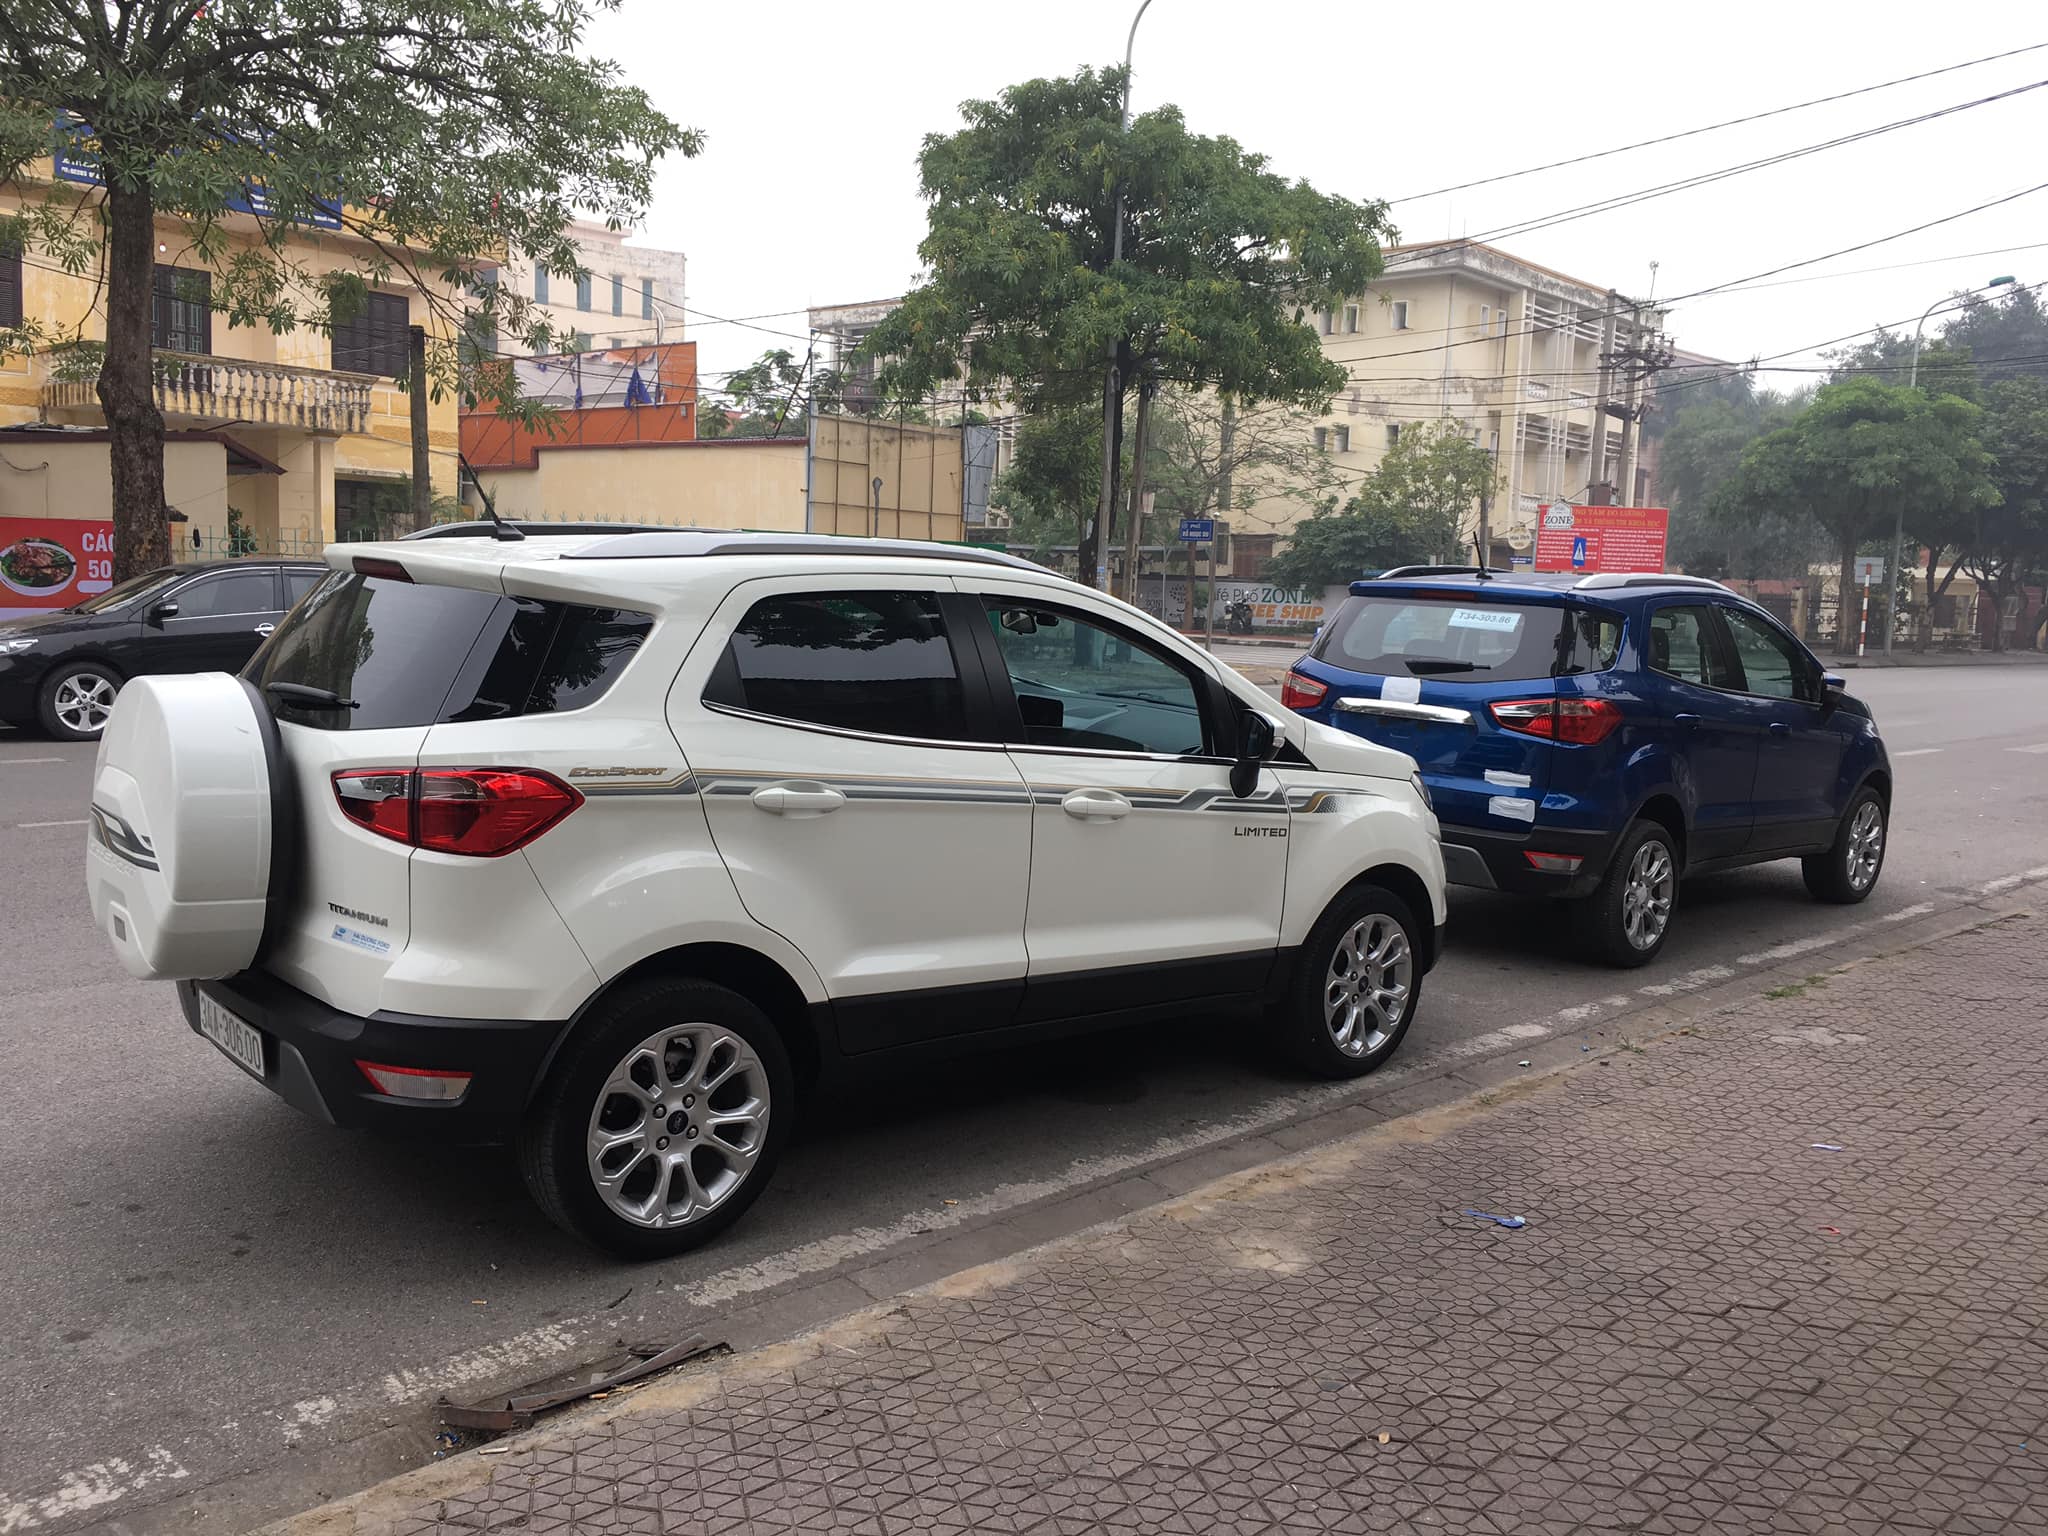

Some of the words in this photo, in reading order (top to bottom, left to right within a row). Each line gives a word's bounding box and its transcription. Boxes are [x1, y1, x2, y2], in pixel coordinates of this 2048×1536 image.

[1545, 515, 1573, 525] ZONE
[1261, 588, 1312, 604] ZONE
[1281, 604, 1324, 620] SHIP
[1234, 826, 1288, 838] LIMITED
[327, 901, 389, 928] TITANIUM
